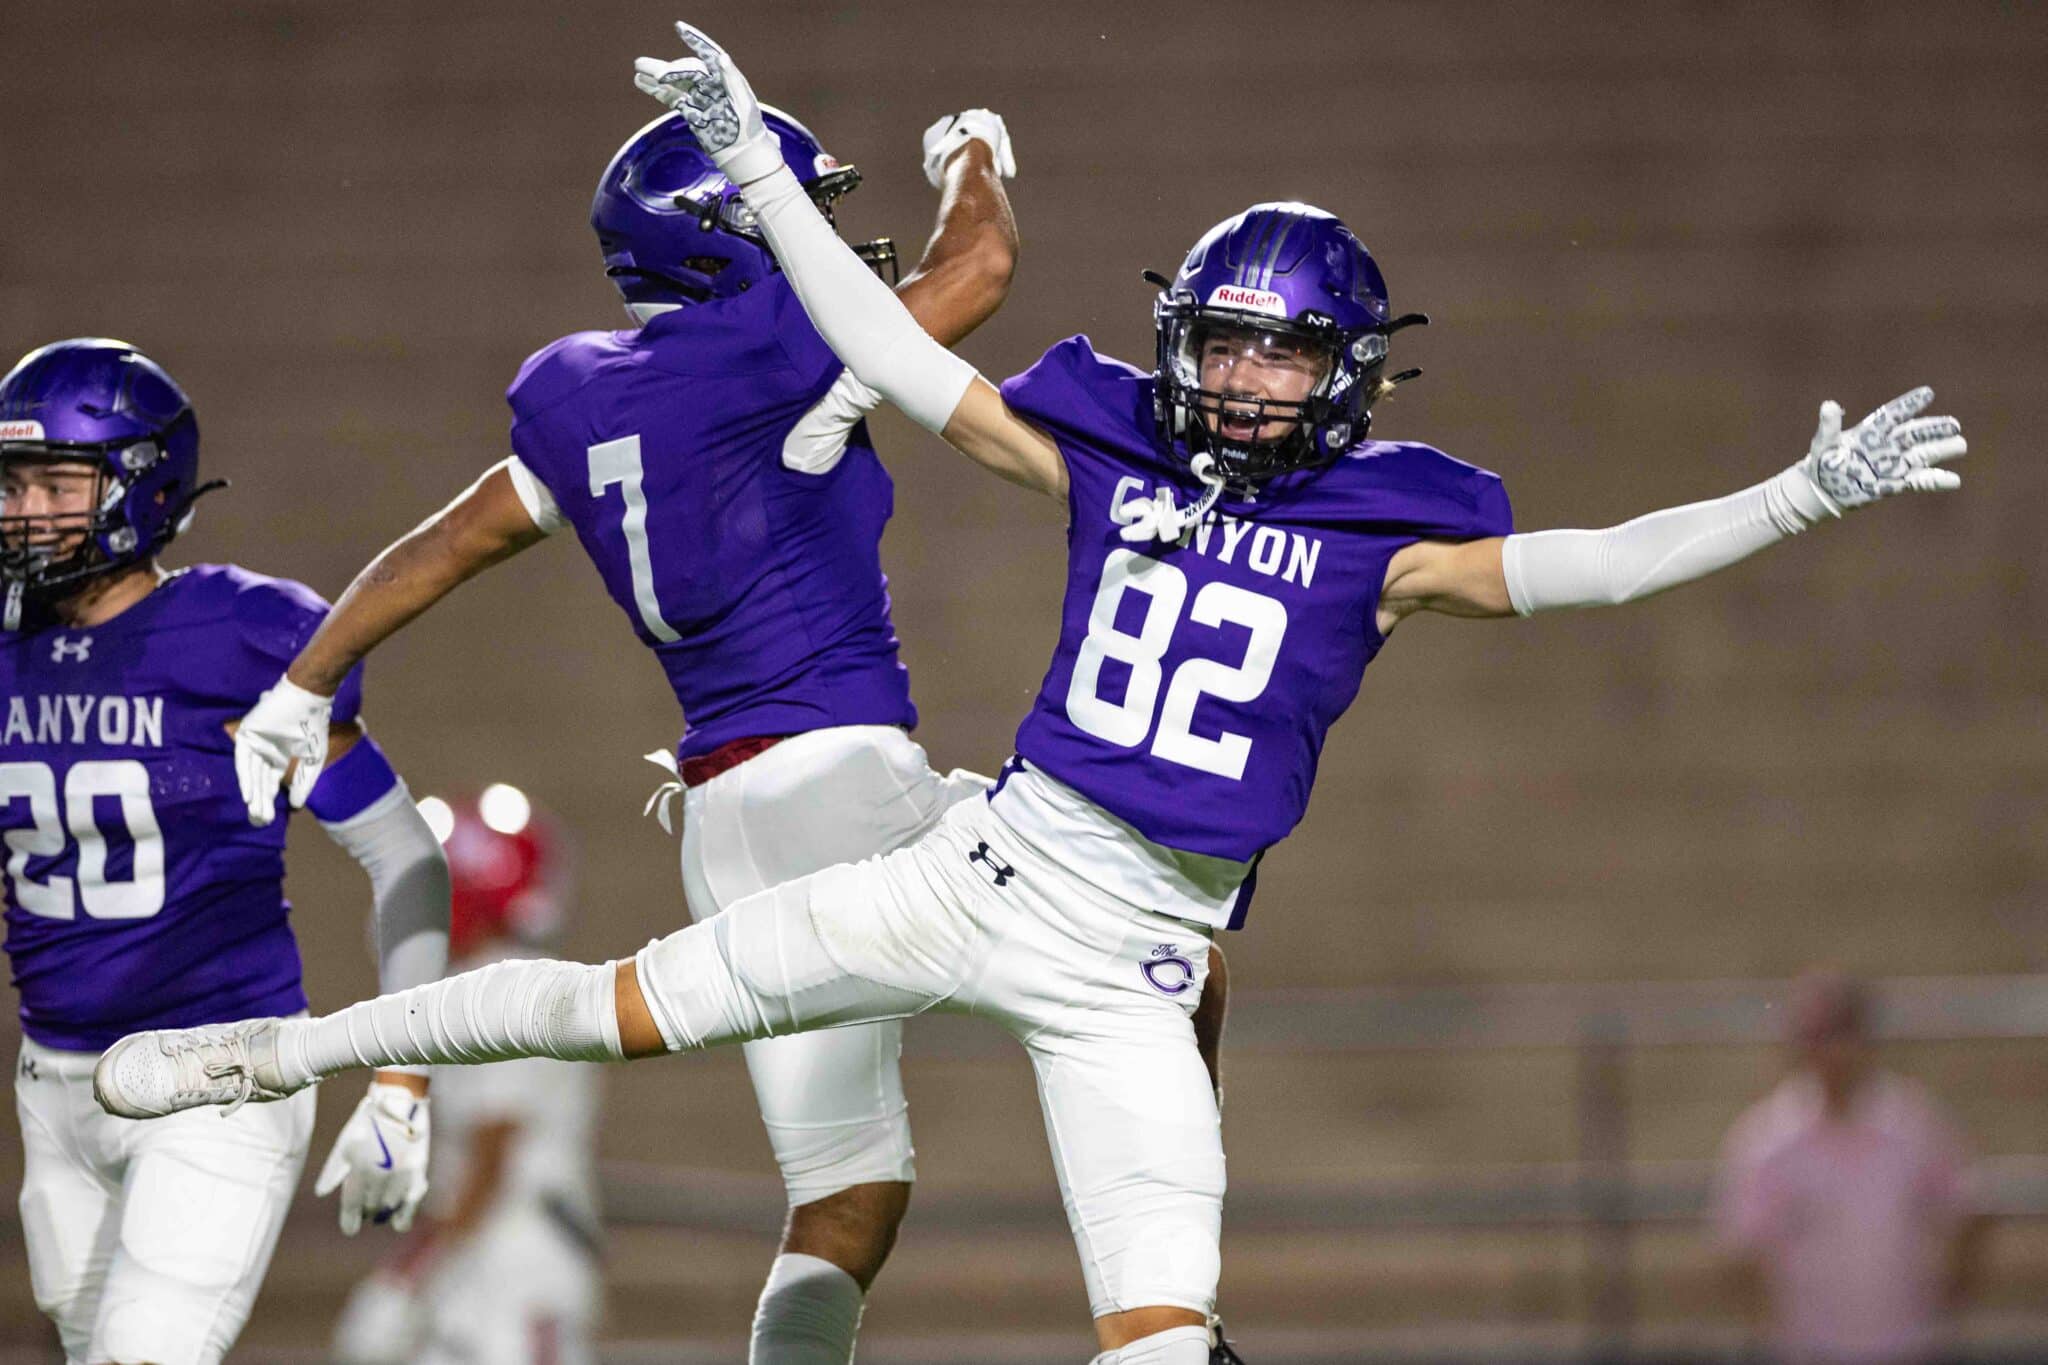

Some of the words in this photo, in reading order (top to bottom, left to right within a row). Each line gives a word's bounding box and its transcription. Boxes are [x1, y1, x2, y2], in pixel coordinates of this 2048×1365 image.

[1218, 288, 1278, 306] Riddell
[587, 433, 683, 643] 7
[1110, 474, 1323, 590] CNYON
[0, 694, 165, 748] ANYON
[1065, 547, 1288, 782] 82
[0, 760, 165, 921] 20
[1139, 955, 1196, 997] C
